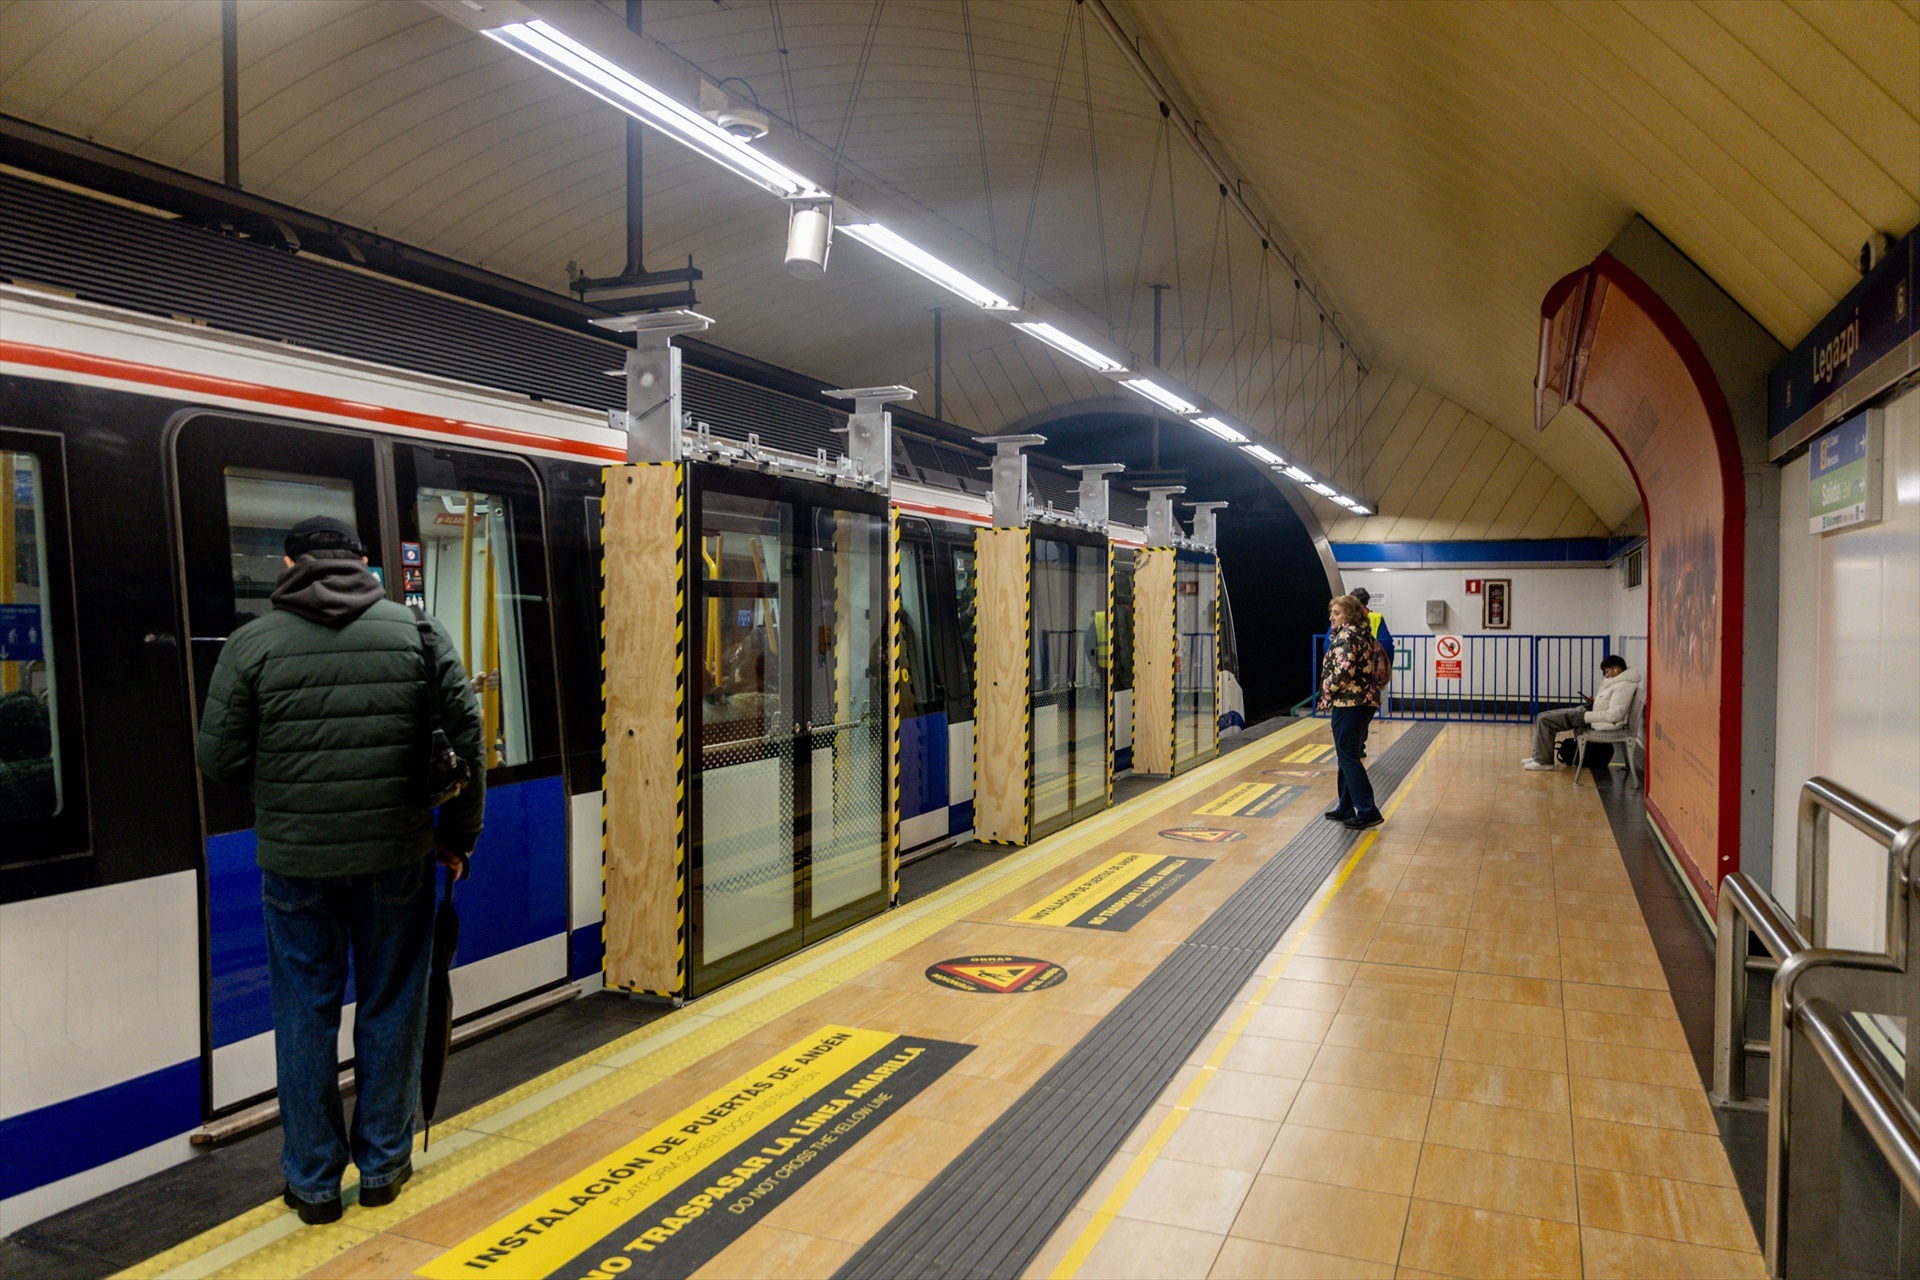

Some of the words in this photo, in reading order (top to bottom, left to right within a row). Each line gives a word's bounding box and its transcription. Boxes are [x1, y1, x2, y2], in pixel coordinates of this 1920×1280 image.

[1812, 306, 1860, 385] Legazpi
[464, 1157, 654, 1270] INSTALACIÓN
[648, 1131, 688, 1156] DE
[680, 1081, 774, 1136] PUERTAS
[768, 1063, 799, 1081] DE
[800, 1031, 853, 1067] ANDÉN
[578, 1256, 633, 1280] NO
[623, 1147, 773, 1254] TRASPASAR
[767, 1129, 803, 1157] LA
[791, 1096, 855, 1137] LÍNEA
[843, 1045, 927, 1100] AMARILLA
[609, 1159, 682, 1208] PLATFORM
[678, 1126, 728, 1163] SCREEN
[727, 1110, 757, 1136] DOOR
[754, 1069, 822, 1118] INSTALLATION
[728, 1193, 756, 1217] DO
[748, 1178, 781, 1204] NOT
[774, 1147, 820, 1181] CROSS
[809, 1132, 840, 1156] THE
[829, 1105, 874, 1142] YELLOW
[866, 1091, 894, 1113] LINE
